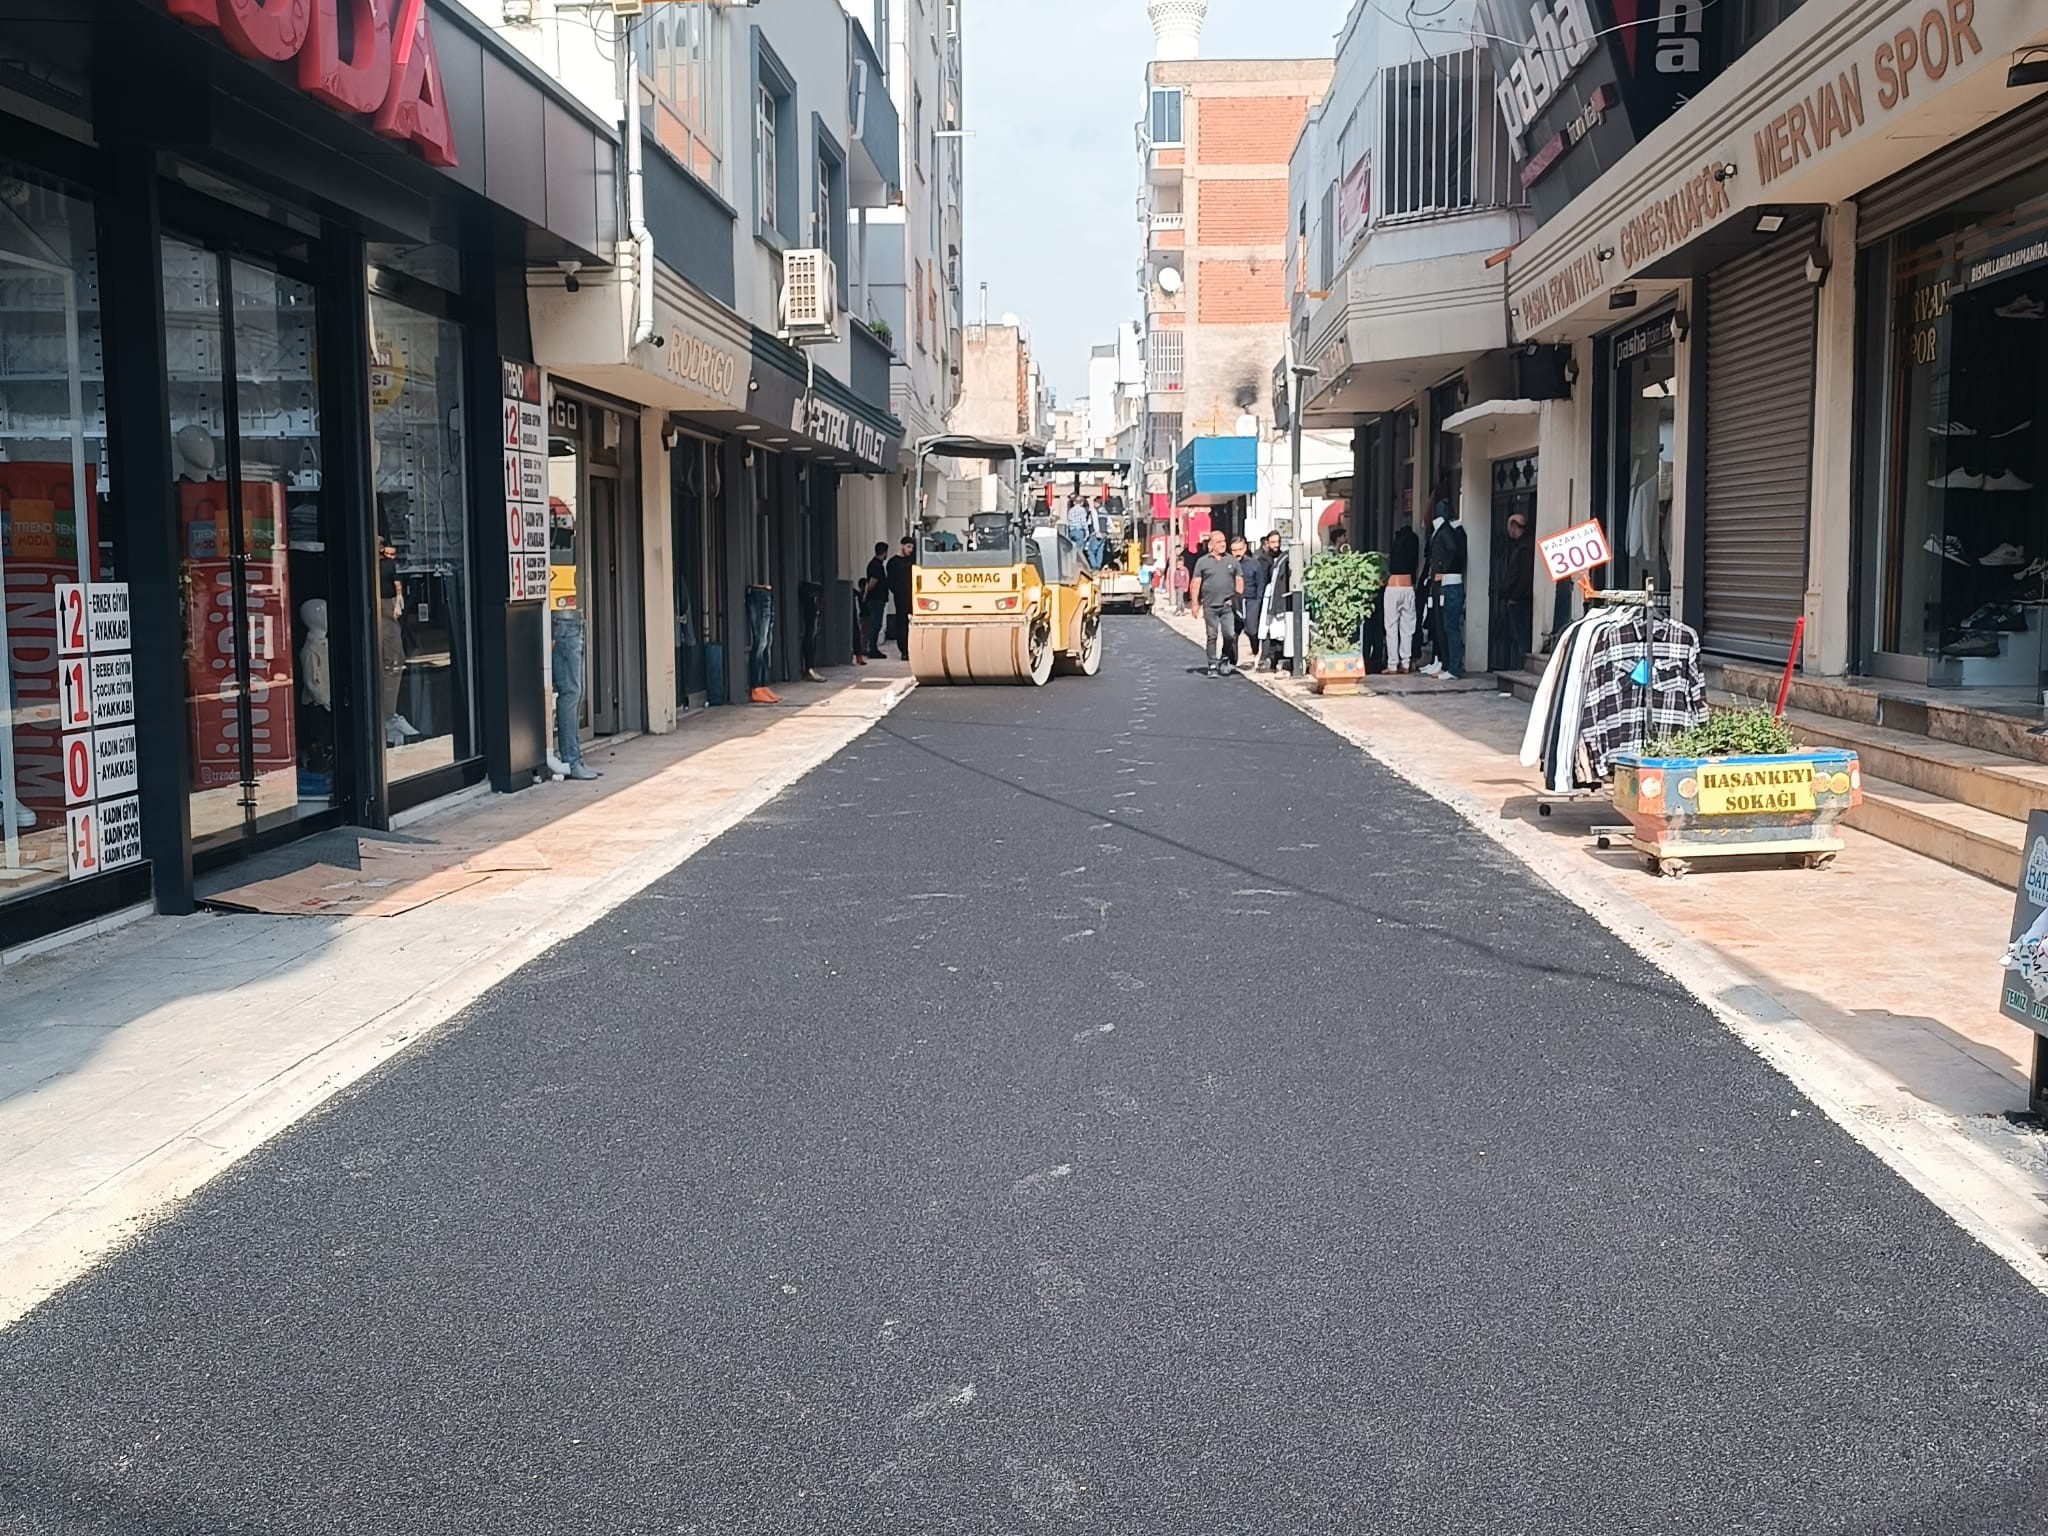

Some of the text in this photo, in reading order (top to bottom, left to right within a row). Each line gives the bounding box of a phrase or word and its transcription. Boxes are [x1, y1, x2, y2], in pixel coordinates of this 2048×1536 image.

[1754, 0, 1983, 186] MERVAN SPOR
[1617, 329, 1646, 368] pasha
[509, 405, 518, 445] 2
[511, 457, 519, 497] 1
[511, 507, 520, 546] 0
[1551, 540, 1602, 574] 300
[957, 573, 1000, 583] BOMAG
[113, 588, 128, 612] GİYİM
[69, 589, 84, 648] 2
[115, 657, 131, 676] GİYİM
[72, 663, 89, 722] 1
[117, 679, 132, 697] GİYİM
[119, 732, 135, 754] GİYİM
[69, 740, 88, 797] 0
[1726, 790, 1796, 811] SOKAĞI
[124, 821, 139, 839] SPOR
[2027, 864, 2048, 890] BAT
